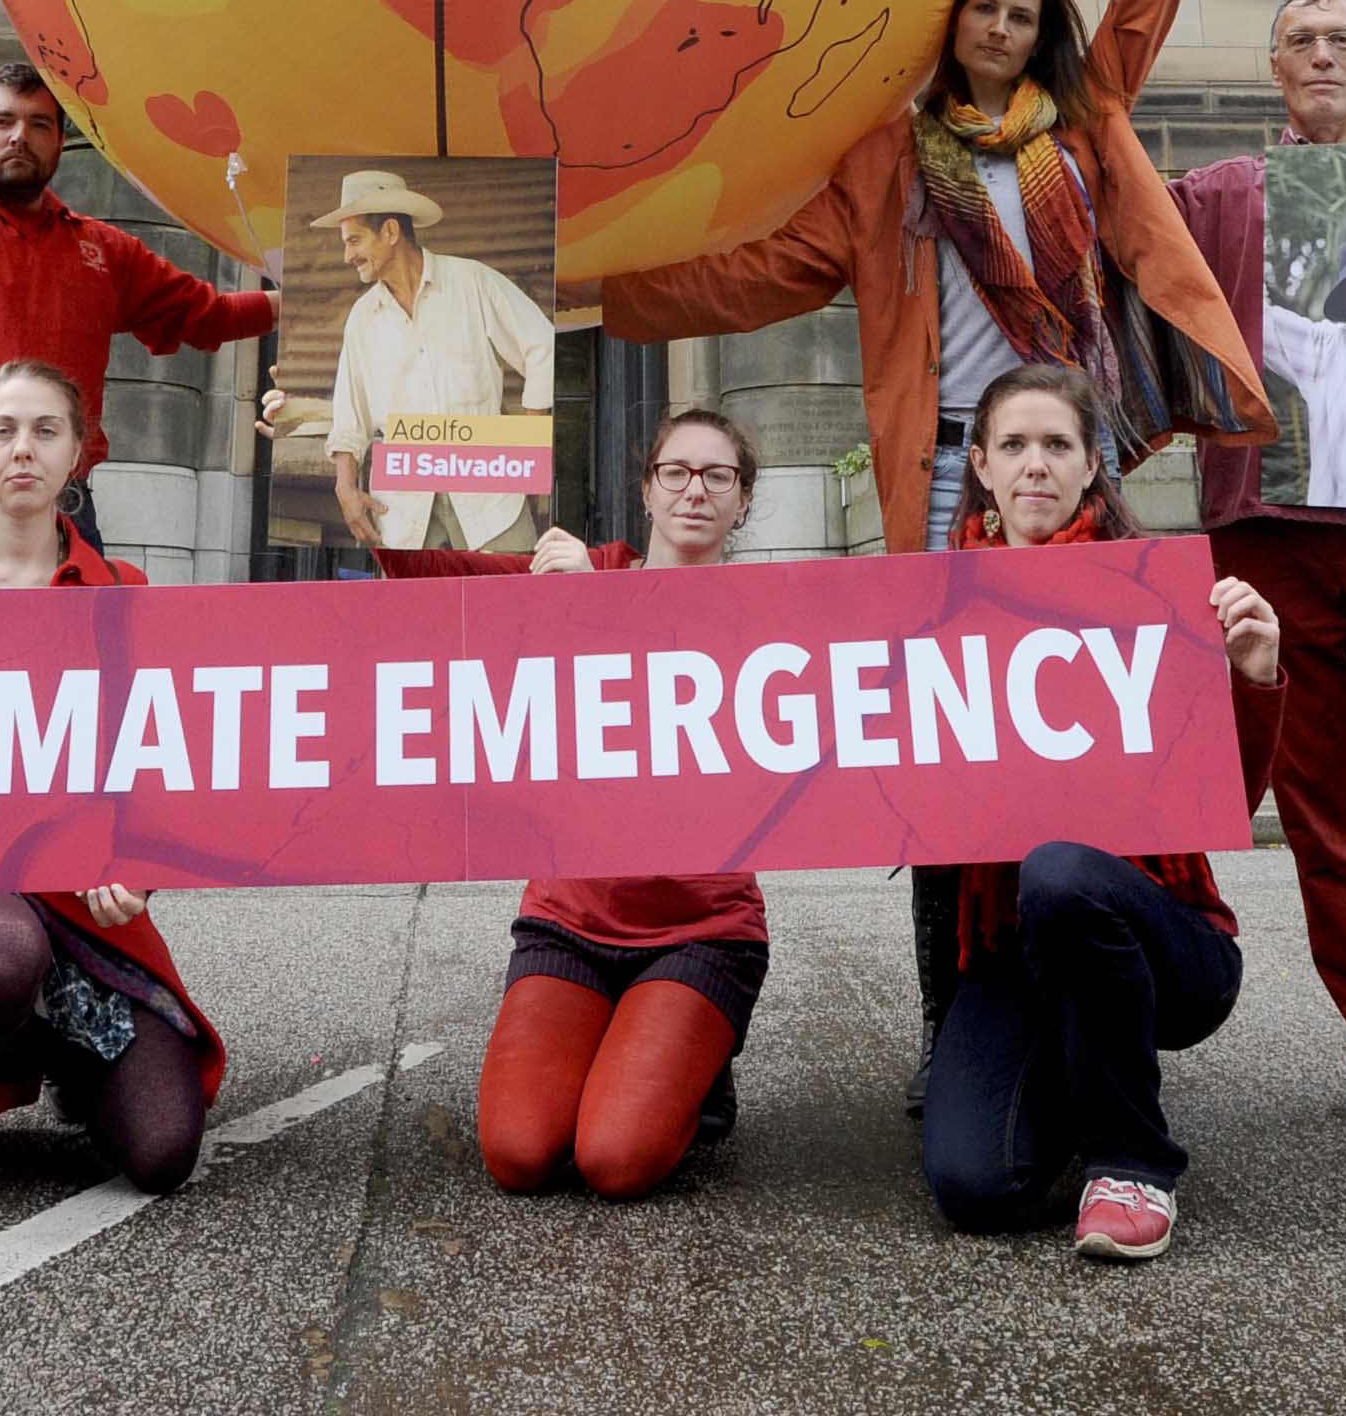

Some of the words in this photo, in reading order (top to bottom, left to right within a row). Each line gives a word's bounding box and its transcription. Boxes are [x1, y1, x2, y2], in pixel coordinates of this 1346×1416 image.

[391, 419, 473, 442] Adolfo
[385, 452, 410, 476] El
[416, 453, 535, 478] Salvador
[376, 623, 1168, 786] EMERGENCY
